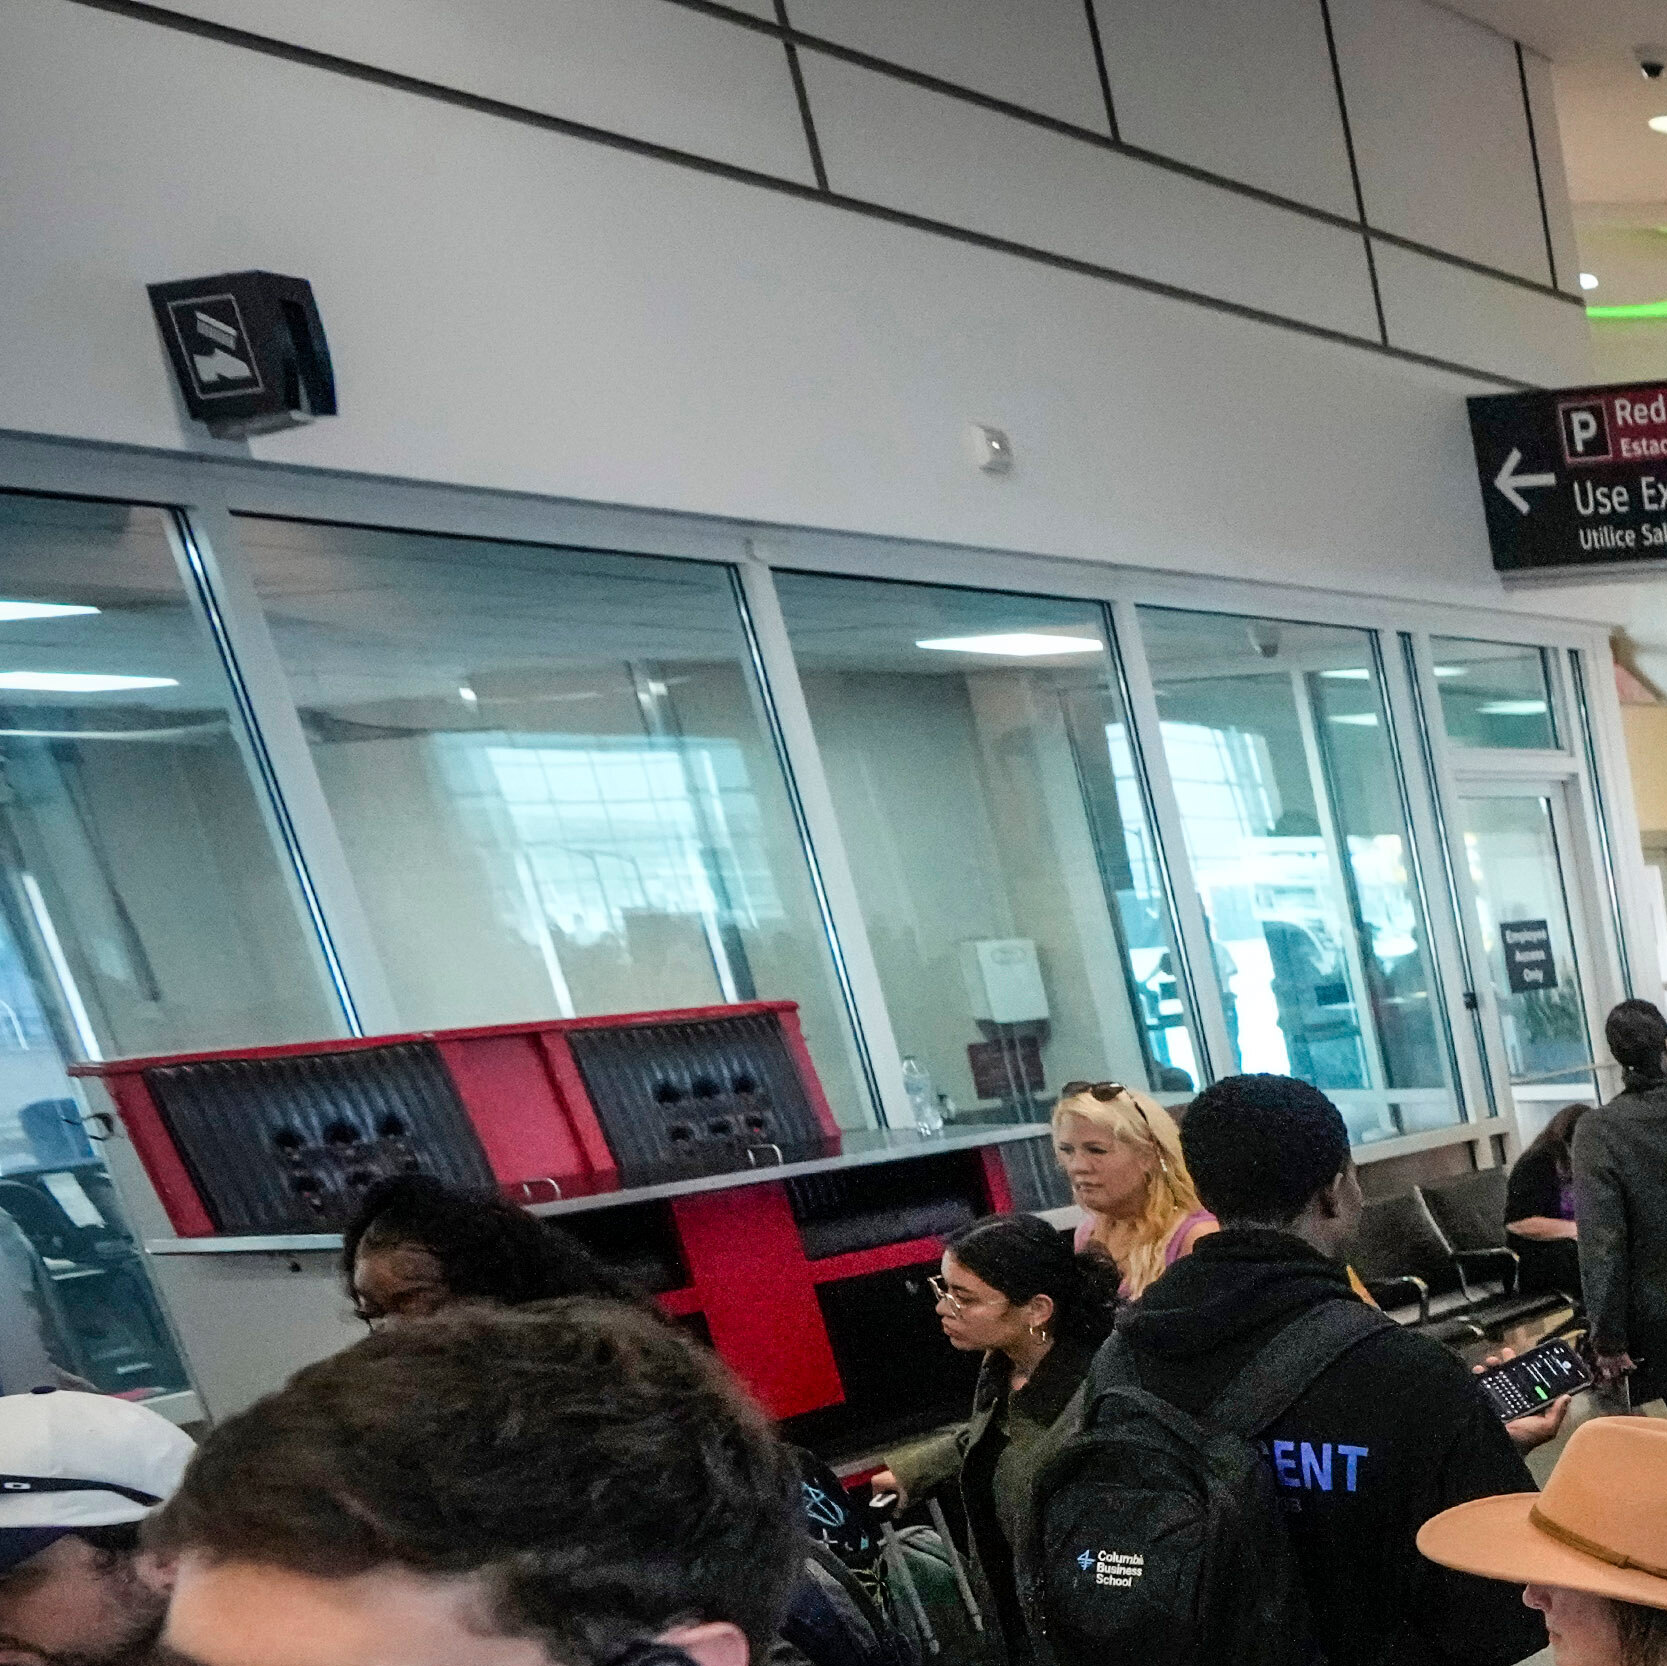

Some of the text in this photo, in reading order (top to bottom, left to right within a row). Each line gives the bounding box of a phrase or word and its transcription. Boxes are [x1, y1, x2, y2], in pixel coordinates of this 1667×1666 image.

[1571, 410, 1597, 453] P
[1614, 394, 1667, 426] Red
[1573, 479, 1630, 515] Use
[1578, 525, 1636, 551] Utilice
[1095, 1573, 1132, 1587] School
[1096, 1562, 1143, 1577] Business
